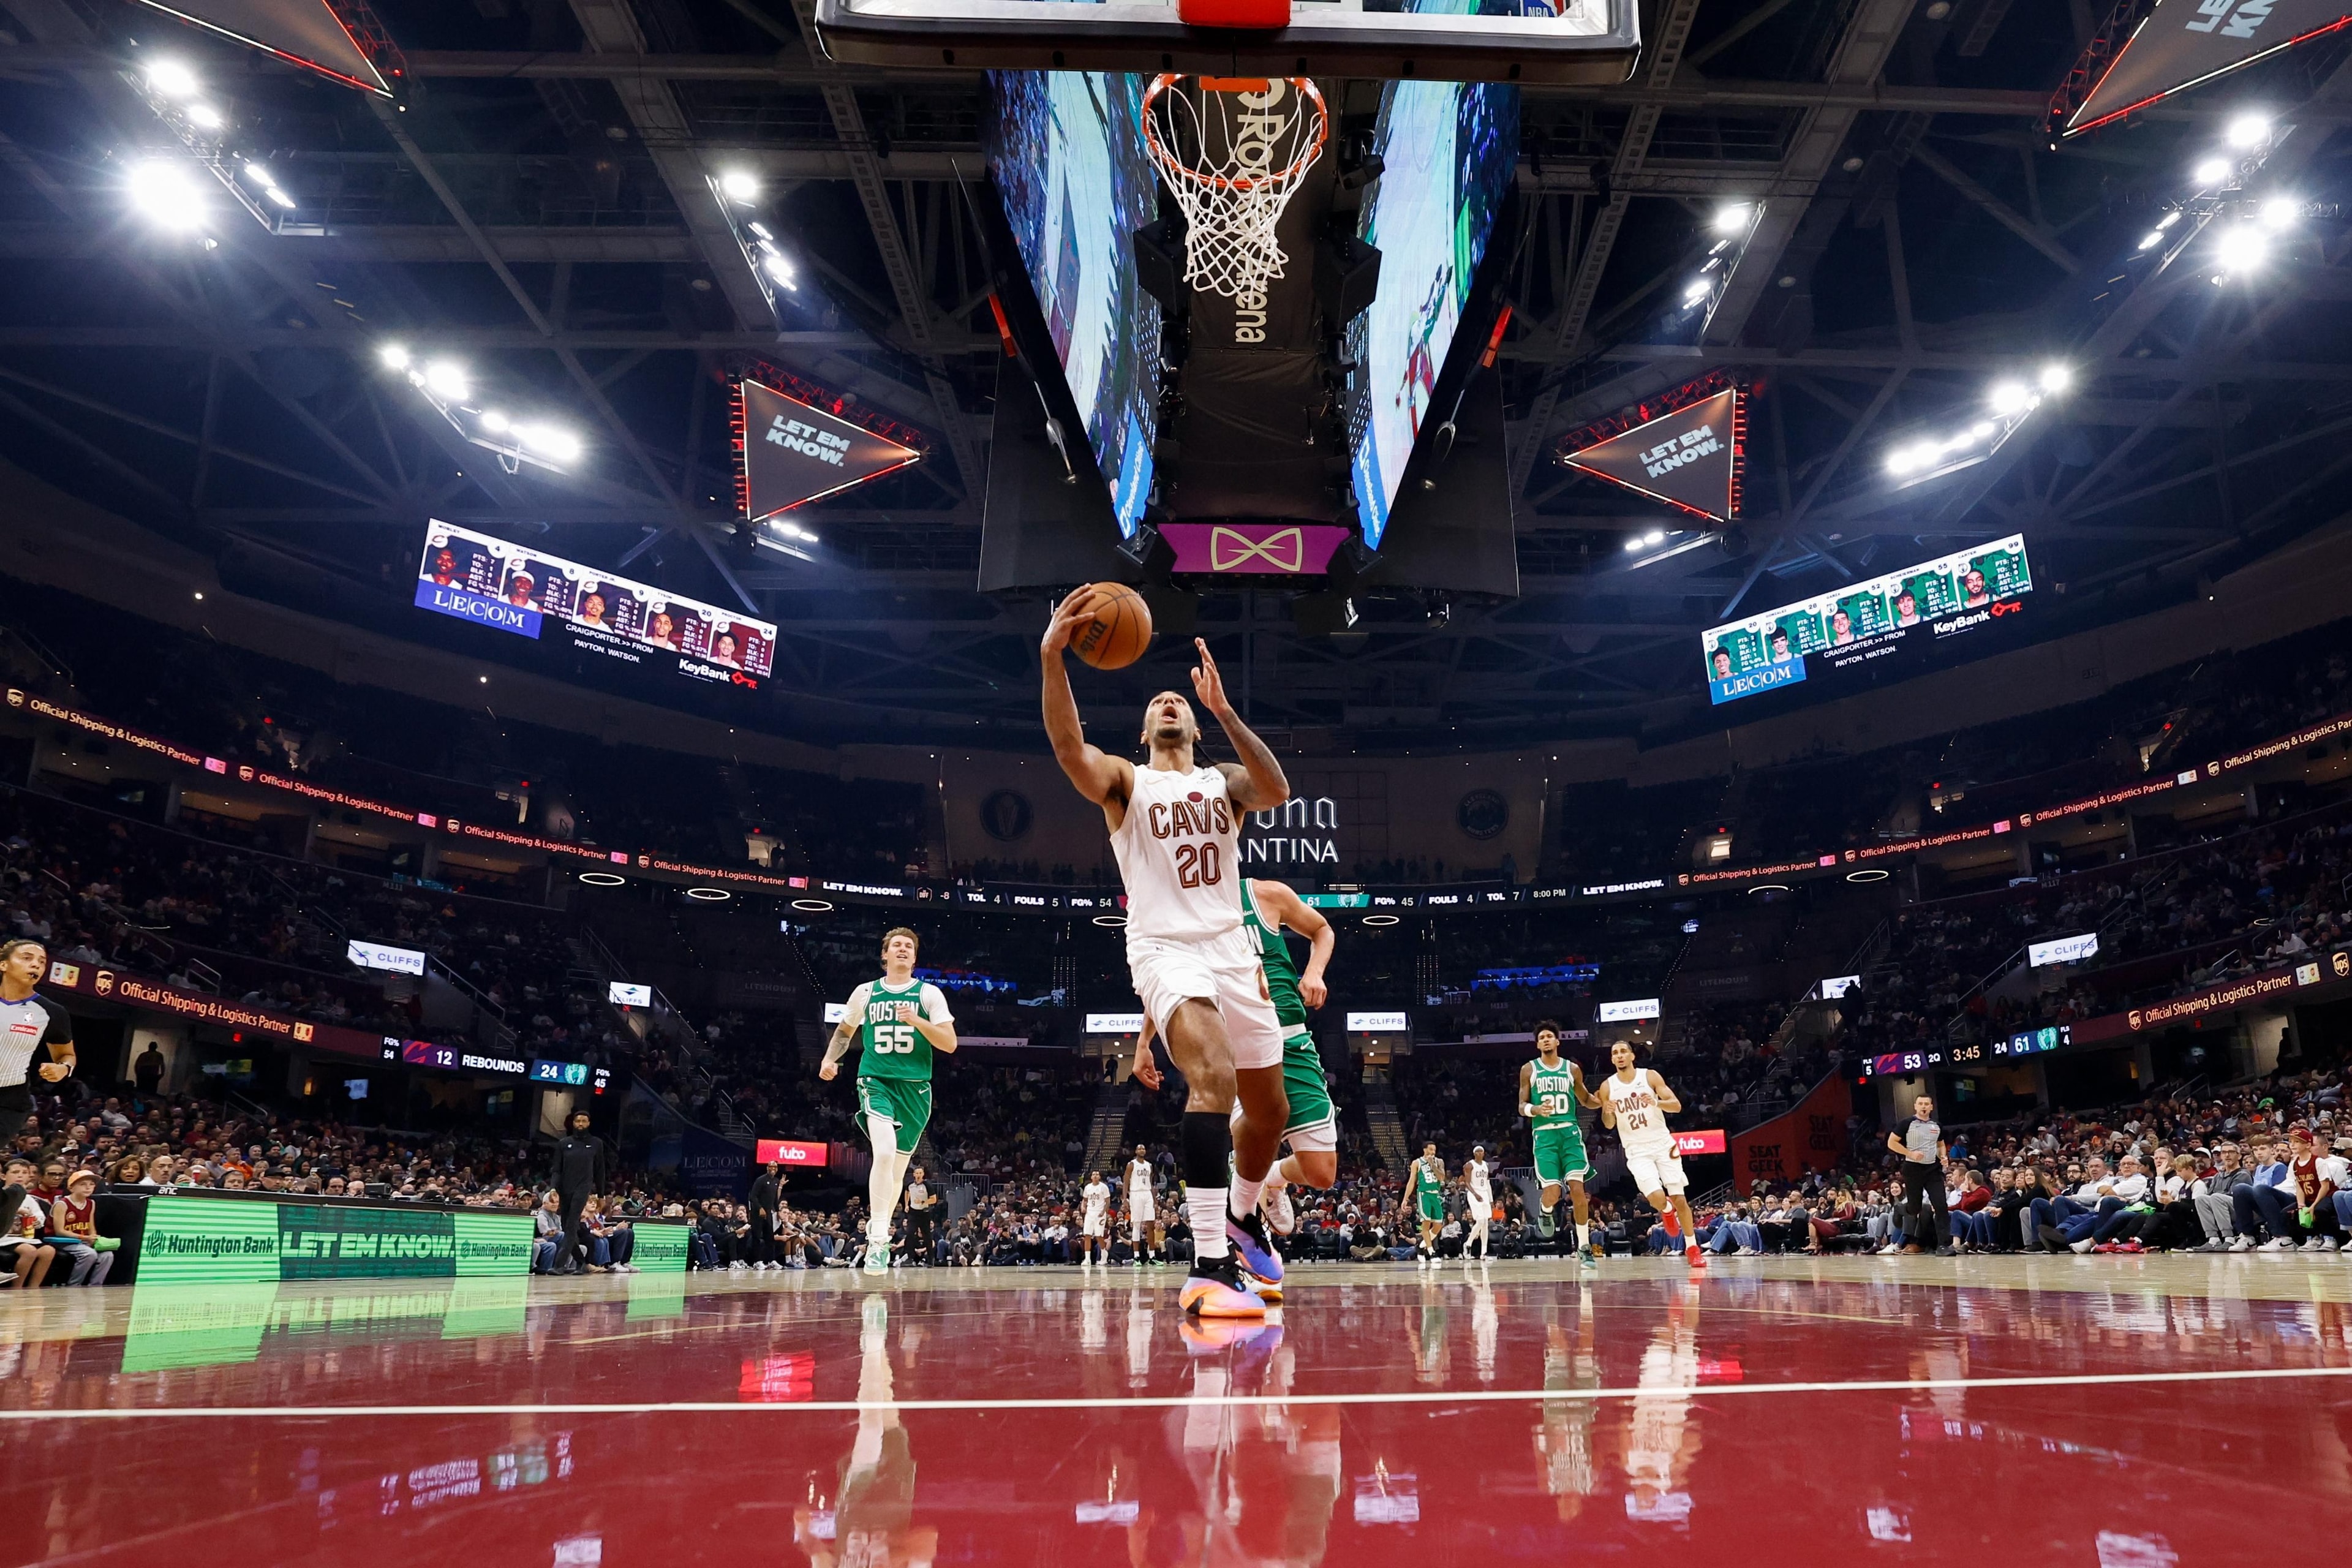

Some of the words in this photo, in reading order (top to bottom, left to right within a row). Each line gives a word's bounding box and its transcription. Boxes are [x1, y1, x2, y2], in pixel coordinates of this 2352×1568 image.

[772, 414, 817, 439] LET
[816, 430, 851, 452] EM
[1639, 439, 1678, 465] LET
[1678, 424, 1713, 447] EM
[766, 428, 845, 467] KNOW.
[1645, 438, 1724, 478] KNOW.
[433, 590, 525, 628] LECOM
[1933, 610, 1990, 635] KeyBank
[1884, 630, 1906, 642] FROM
[574, 639, 606, 654] PAYTON.
[608, 648, 641, 663] WATSON.
[632, 642, 654, 654] FROM
[1835, 654, 1864, 668] PAYTON.
[1865, 646, 1898, 659] WATSON.
[679, 658, 730, 682] KeyBank
[1723, 665, 1792, 696] LECOM
[31, 700, 68, 719] Official
[70, 713, 115, 737] Shipping
[116, 729, 124, 738] &
[126, 732, 166, 752] Logistics
[167, 747, 200, 764] Partner
[2225, 752, 2252, 768] Official
[2253, 741, 2290, 758] Shipping
[2299, 725, 2336, 742] Logistics
[260, 774, 293, 789] Official
[295, 783, 335, 801] Shipping
[345, 796, 382, 812] Logistics
[383, 807, 413, 821] Partner
[2037, 808, 2062, 820] Official
[2064, 800, 2098, 813] Shipping
[2107, 788, 2141, 802] Logistics
[2143, 781, 2173, 794] Partner
[1149, 797, 1230, 839] CAVS
[465, 826, 494, 838] Official
[496, 832, 533, 846] Shipping
[543, 840, 576, 853] Logistics
[578, 848, 606, 859] Partner
[1861, 846, 1885, 857] Official
[1887, 842, 1920, 853] Shipping
[1928, 834, 1961, 845] Logistics
[1962, 829, 1989, 839] Partner
[654, 861, 680, 871] Official
[682, 865, 715, 877] Shipping
[725, 871, 756, 881] Logistics
[758, 876, 785, 884] Partner
[1176, 842, 1221, 889] 20
[1694, 873, 1717, 881] Official
[1719, 870, 1751, 879] Shipping
[1759, 865, 1790, 875] Logistics
[823, 881, 845, 891] LET
[846, 884, 863, 893] EM
[864, 886, 903, 896] KNOW.
[1307, 897, 1321, 907] 61
[1401, 897, 1414, 906] 45
[1429, 895, 1458, 905] FOULS
[1467, 894, 1473, 903] 4
[1513, 892, 1519, 900] 7
[1553, 889, 1566, 897] PM
[1583, 886, 1606, 895] LET
[1607, 884, 1624, 893] EM
[1625, 879, 1664, 891] KNOW.
[940, 891, 950, 900] -8
[967, 893, 986, 902] TOL
[993, 895, 1000, 903] 4
[1014, 896, 1044, 906] FOULS
[1052, 898, 1058, 907] 5
[1071, 899, 1093, 907] FG%
[1099, 899, 1112, 907] 54
[377, 953, 421, 967] CLIFFS
[121, 982, 160, 1002] Official
[161, 992, 207, 1016] Shipping
[208, 1003, 216, 1016] &
[217, 1005, 257, 1025] Logistics
[258, 1016, 290, 1033] Partner
[1623, 1005, 1657, 1014] CLIFFS
[2146, 1005, 2172, 1022] Official
[2173, 998, 2209, 1015] Shipping
[2211, 993, 2217, 1005] &
[2218, 985, 2255, 1003] Logistics
[2257, 975, 2291, 993] Partner
[383, 1037, 399, 1047] FG%
[874, 1025, 914, 1054] 55
[2064, 1035, 2070, 1045] 4
[383, 1050, 394, 1060] 54
[436, 1050, 453, 1065] 12
[462, 1055, 525, 1073] REBOUNDS
[540, 1065, 558, 1078] 24
[1904, 1054, 1921, 1069] 53
[1928, 1052, 1940, 1063] 2Q
[1953, 1046, 1980, 1061] 3:45
[1994, 1042, 2007, 1054] 24
[2015, 1036, 2030, 1053] 61
[1866, 1066, 1872, 1076] 5
[594, 1078, 606, 1088] 45
[1536, 1076, 1570, 1094] BOSTON
[1628, 1112, 1648, 1131] 24
[778, 1146, 806, 1159] fubo
[1679, 1137, 1705, 1150] fubo
[1749, 1144, 1781, 1158] SEAT
[684, 1156, 746, 1169] LECOM
[1748, 1159, 1785, 1172] GEEK
[2303, 1182, 2314, 1195] 15
[167, 1235, 241, 1258] Huntington
[243, 1236, 274, 1254] Bank
[281, 1231, 337, 1258] LET
[339, 1232, 379, 1258] EM
[379, 1234, 455, 1258] KNOW.
[471, 1243, 510, 1261] Huntington
[510, 1244, 526, 1256] Bank
